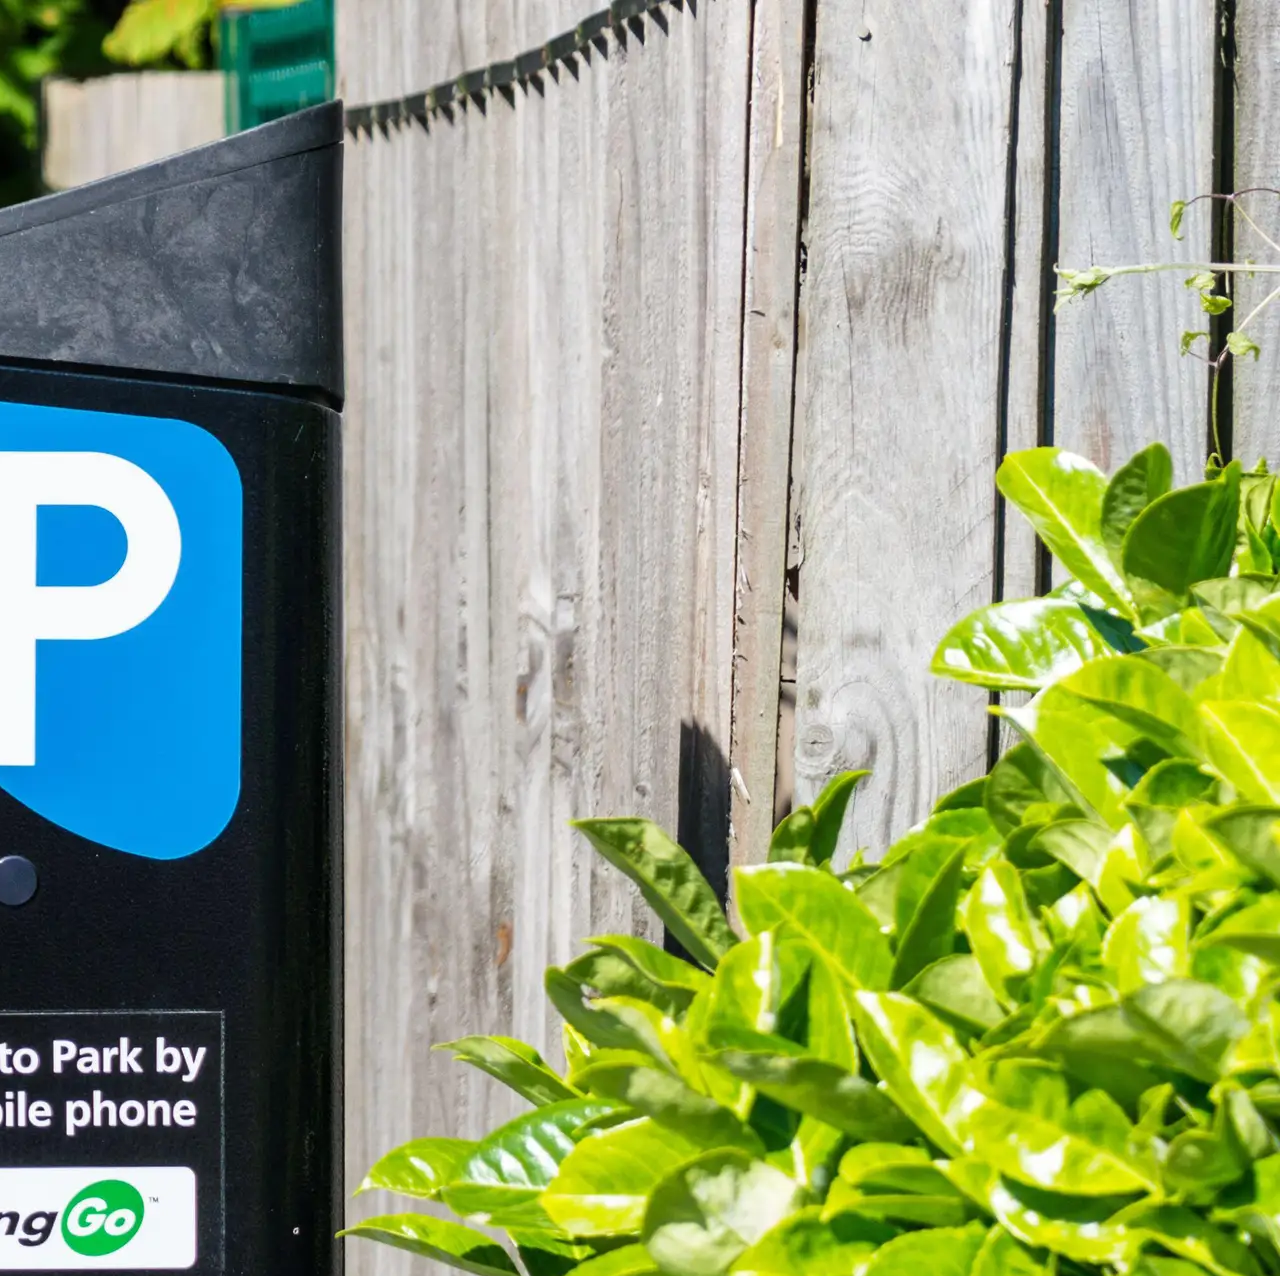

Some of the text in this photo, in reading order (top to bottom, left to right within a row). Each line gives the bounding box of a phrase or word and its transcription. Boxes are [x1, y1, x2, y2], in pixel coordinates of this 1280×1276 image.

[52, 1036, 144, 1074] Park
[156, 1036, 207, 1083] by
[65, 1089, 197, 1136] phone
